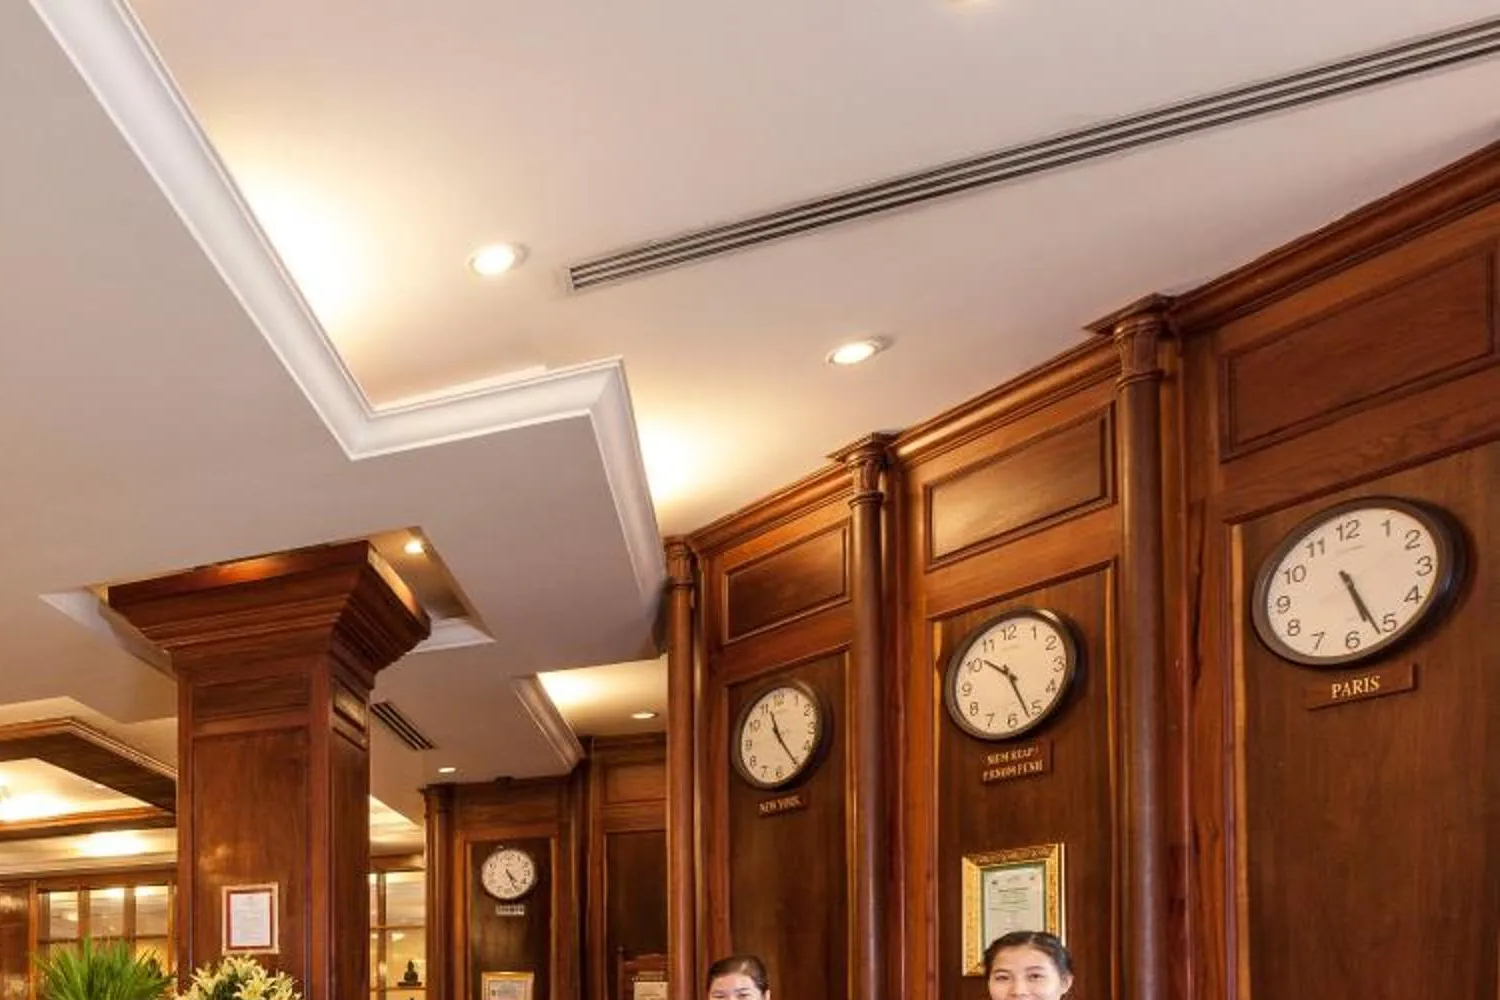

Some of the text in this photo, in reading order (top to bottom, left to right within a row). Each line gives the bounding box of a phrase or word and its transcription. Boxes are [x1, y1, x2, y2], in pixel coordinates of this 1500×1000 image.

[1335, 519, 1360, 542] 12
[1381, 519, 1391, 537] 1
[1306, 538, 1326, 558] 11
[1404, 529, 1421, 551] 2
[1283, 564, 1307, 585] 10
[1416, 555, 1433, 576] 3
[1403, 585, 1422, 605] 4
[1276, 595, 1291, 614] 9
[1000, 623, 1017, 641] 12
[1287, 618, 1301, 637] 8
[1382, 613, 1397, 633] 5
[1030, 625, 1037, 641] 1
[1311, 631, 1325, 650] 7
[1345, 630, 1360, 649] 6
[982, 638, 995, 653] 11
[1045, 634, 1057, 651] 2
[966, 657, 983, 673] 10
[1052, 656, 1065, 673] 3
[961, 681, 973, 697] 9
[1045, 678, 1056, 694] 4
[1331, 675, 1381, 699] PARIS
[969, 701, 979, 717] 8
[1031, 699, 1042, 715] 5
[984, 712, 995, 728] 7
[1007, 712, 1019, 728] 6
